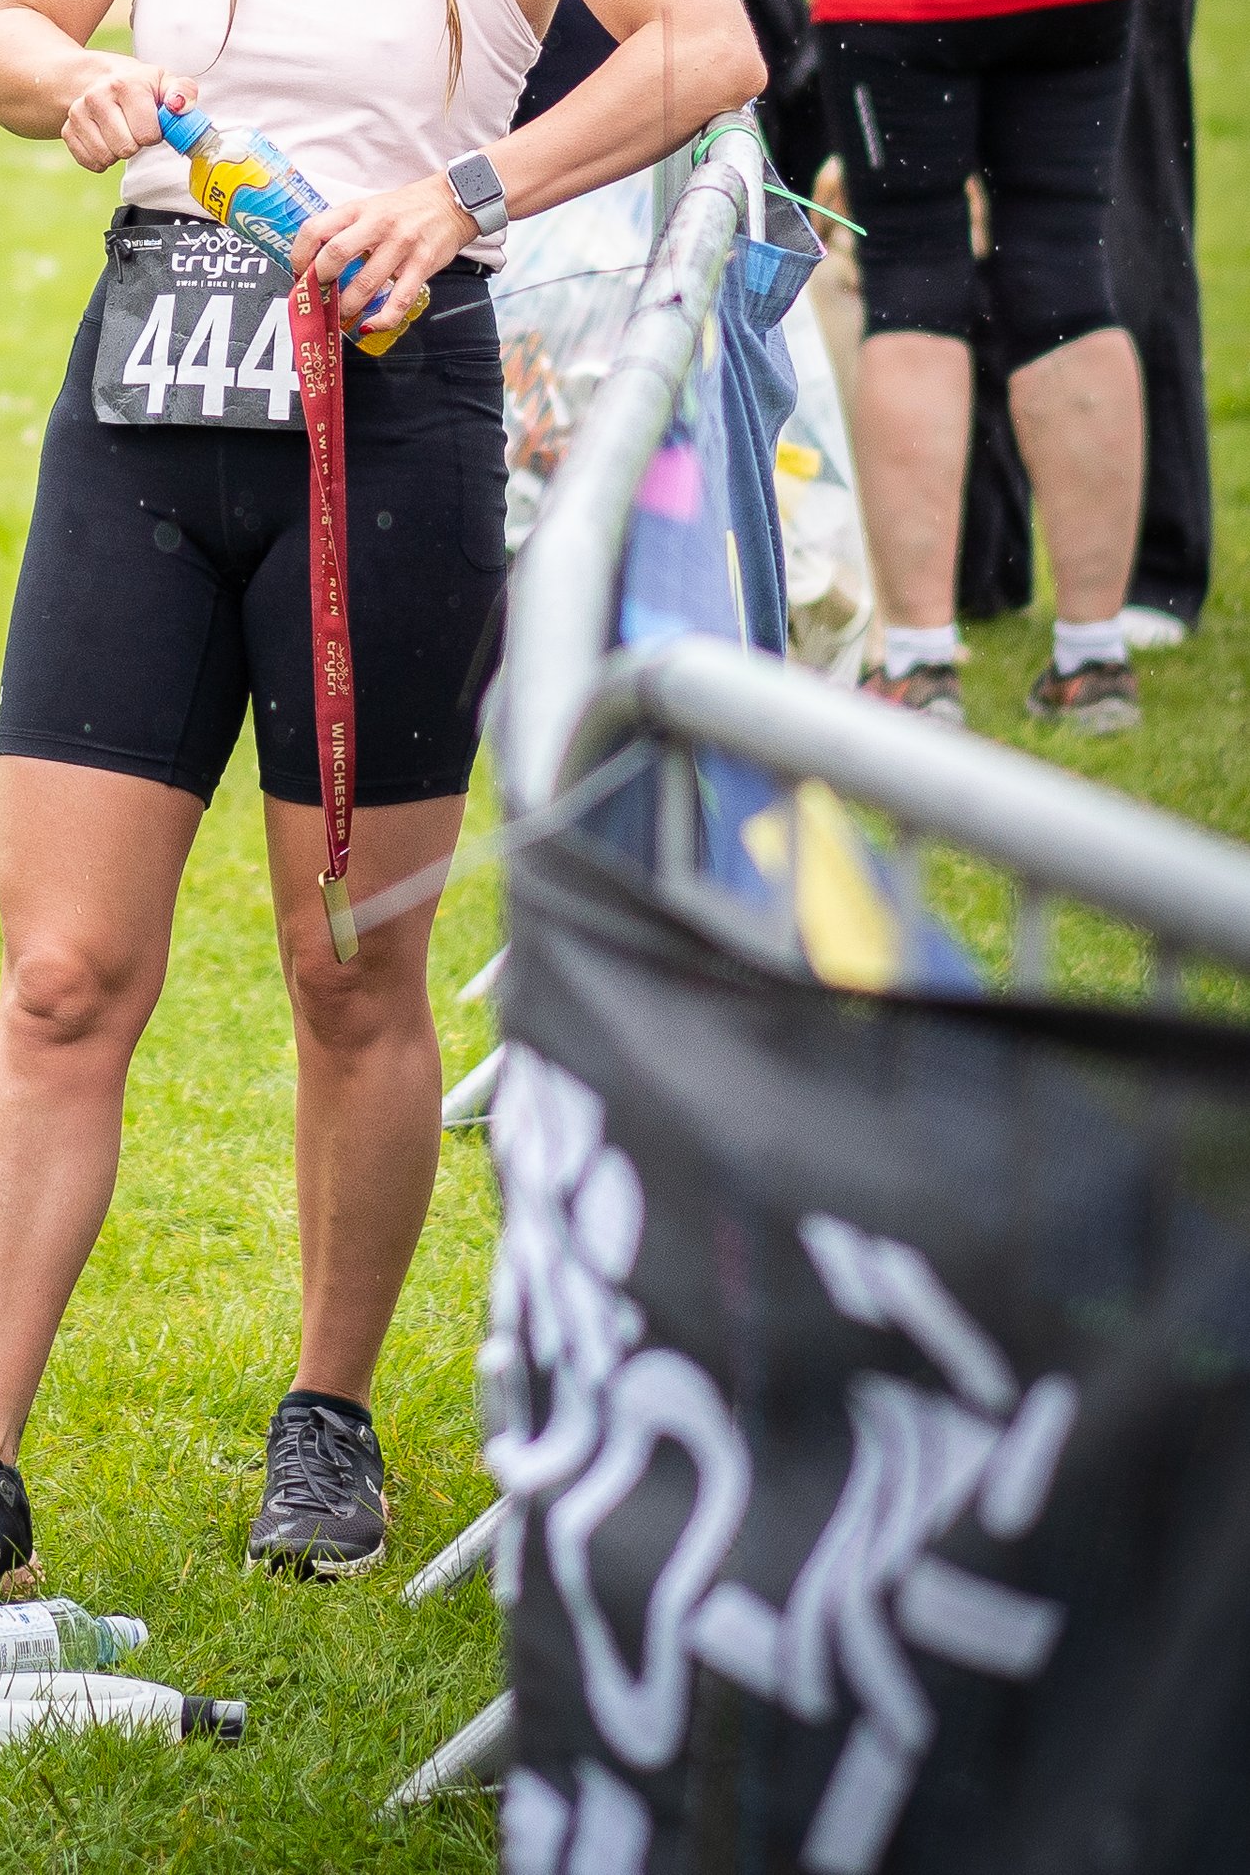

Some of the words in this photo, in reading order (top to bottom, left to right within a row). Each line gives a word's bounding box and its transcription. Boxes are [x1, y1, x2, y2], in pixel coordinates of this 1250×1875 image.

[171, 252, 268, 279] trytri
[207, 280, 228, 288] BIKE
[237, 281, 257, 289] RUN
[122, 294, 301, 421] 444
[300, 341, 317, 398] trytri
[329, 577, 339, 616] RUN
[324, 640, 337, 696] trytri
[332, 721, 346, 841] WINCHESTER
